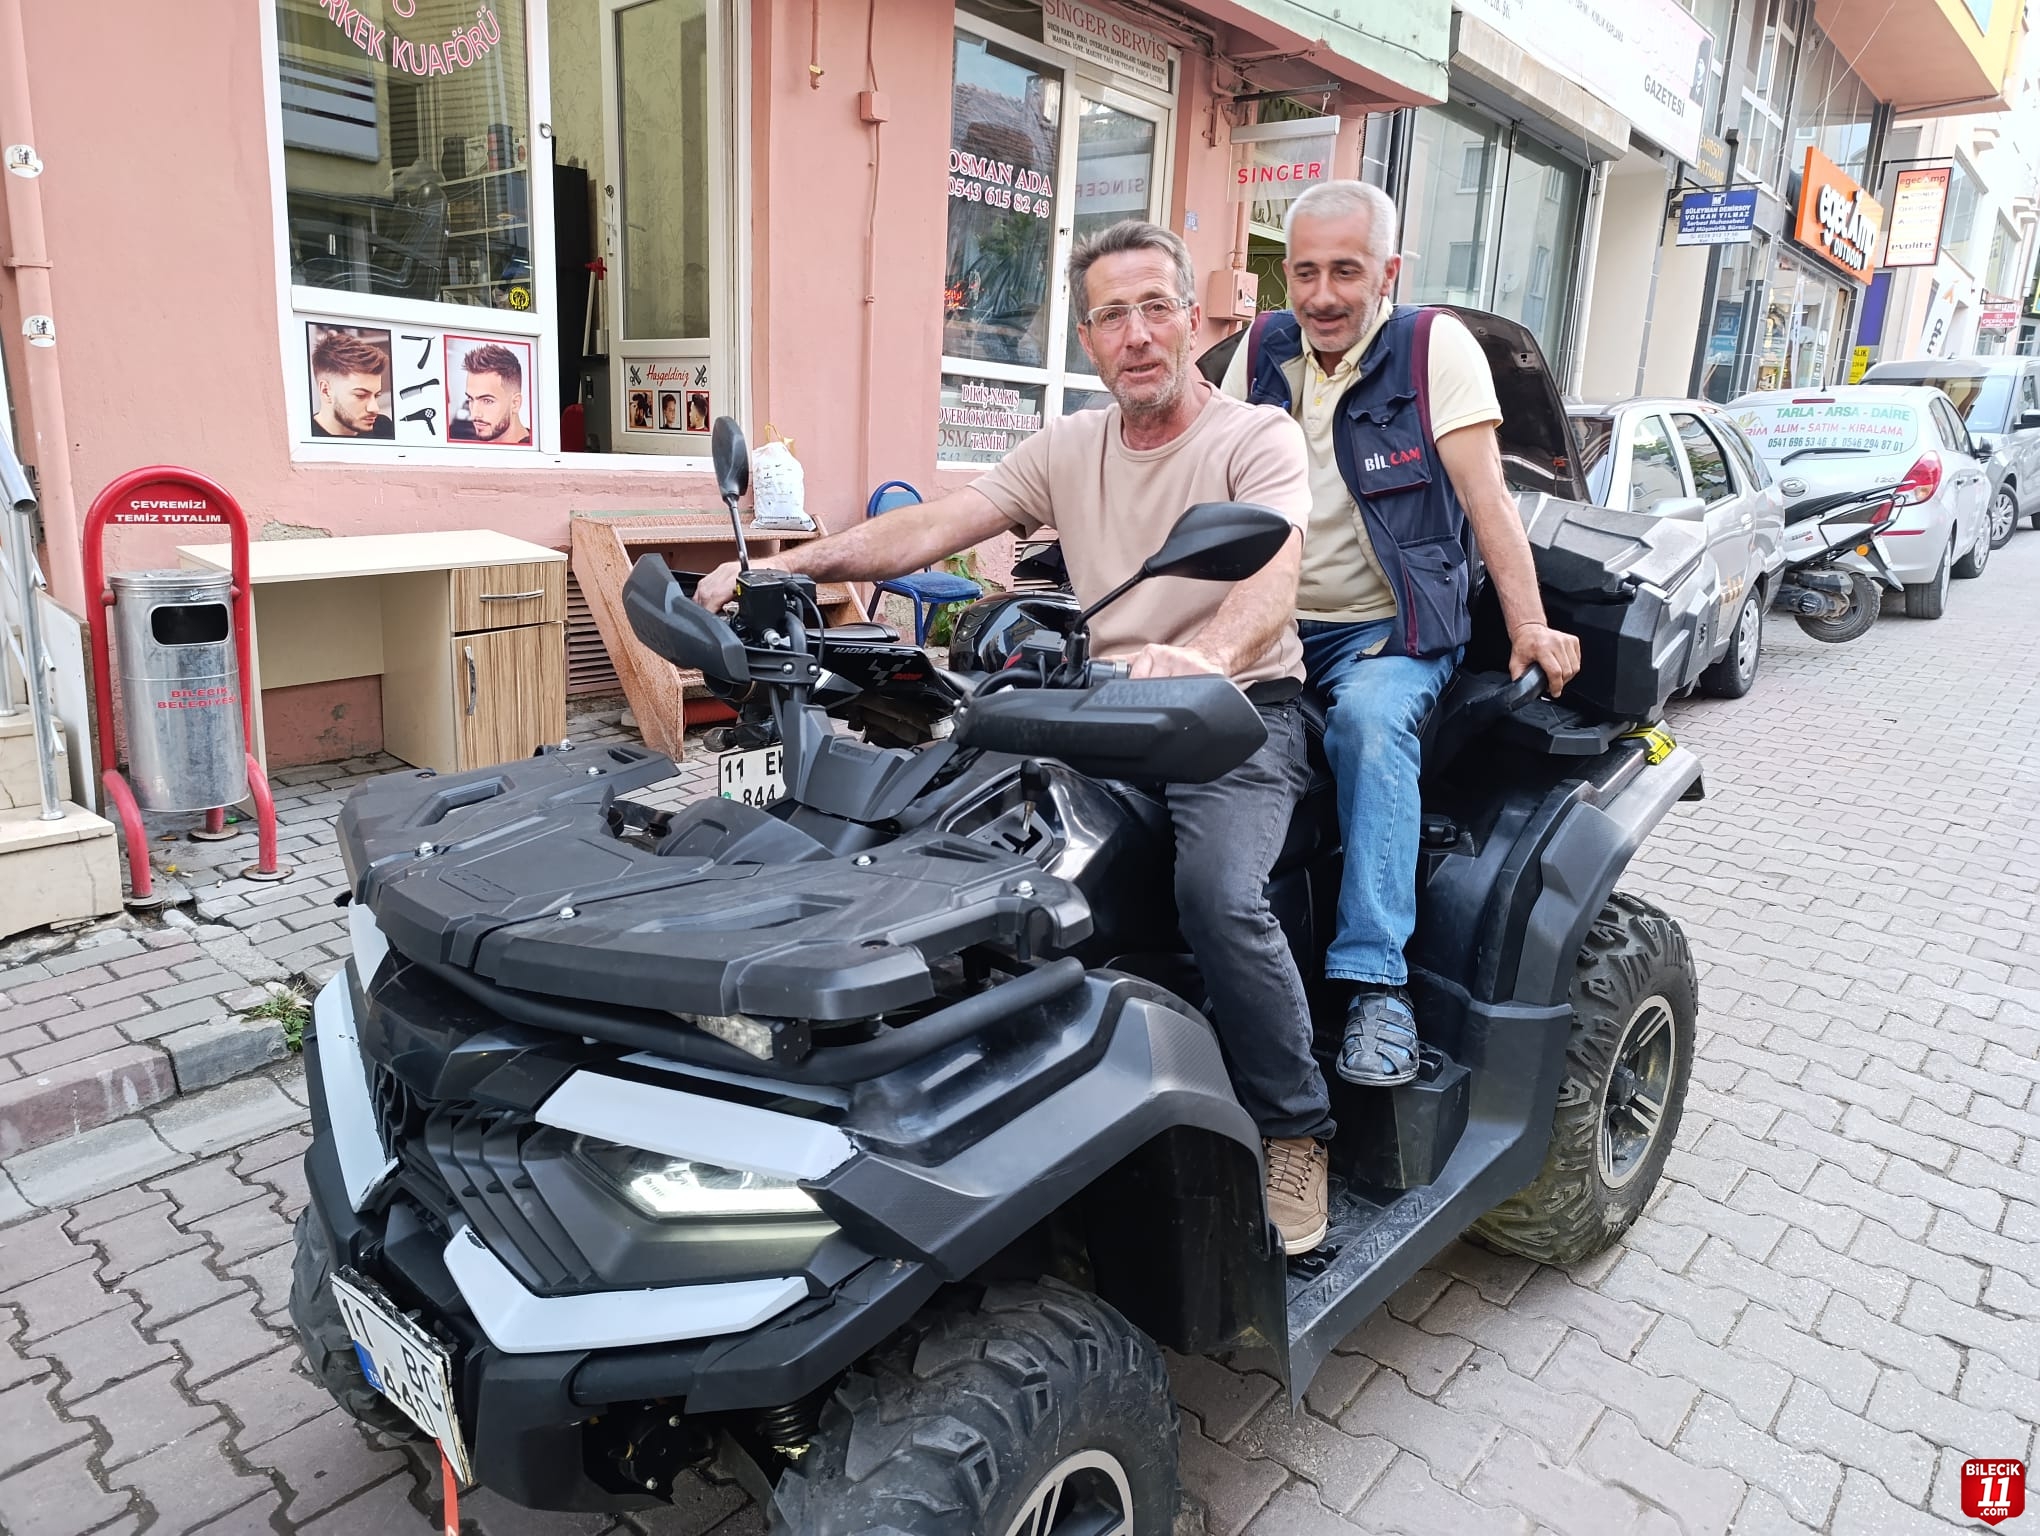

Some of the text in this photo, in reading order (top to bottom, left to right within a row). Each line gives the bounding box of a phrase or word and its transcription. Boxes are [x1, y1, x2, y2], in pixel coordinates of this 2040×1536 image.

[320, 0, 501, 77] RKEK KUAFÖRÜ
[1045, 0, 1167, 62] SINGER SERVİS
[1644, 74, 1686, 118] GAZETESİ
[948, 149, 1053, 197] OSMAN ADA
[1237, 161, 1321, 185] SINGER
[948, 176, 1050, 218] 0543 615 82 43
[1685, 211, 1750, 221] VOLKAN YILMAZ
[1833, 238, 1869, 271] OUTDOOR
[939, 407, 1042, 432] OVERLOK MAKİNELERİ
[1776, 407, 1814, 419] TARLA
[1824, 406, 1860, 417] ARSA
[1871, 406, 1910, 421] DAİRE
[971, 430, 1006, 452] TAMİRİ
[1774, 424, 1799, 433] ALIM
[1808, 423, 1839, 433] SATIM
[1849, 423, 1904, 436] KIRALAMA
[1768, 437, 1786, 448] 0541
[1789, 437, 1803, 447] 696
[1805, 437, 1815, 447] 53
[1817, 437, 1827, 447] 46
[1842, 437, 1862, 448] 0546
[1864, 438, 1879, 449] 294
[1881, 439, 1892, 450] 87
[1893, 441, 1904, 451] 01
[130, 500, 207, 510] ÇEVREMİZİ
[115, 513, 221, 523] TEMİZ TUTALIM
[725, 758, 744, 783] 11
[743, 784, 777, 807] 844
[343, 1298, 442, 1412] 11 BC
